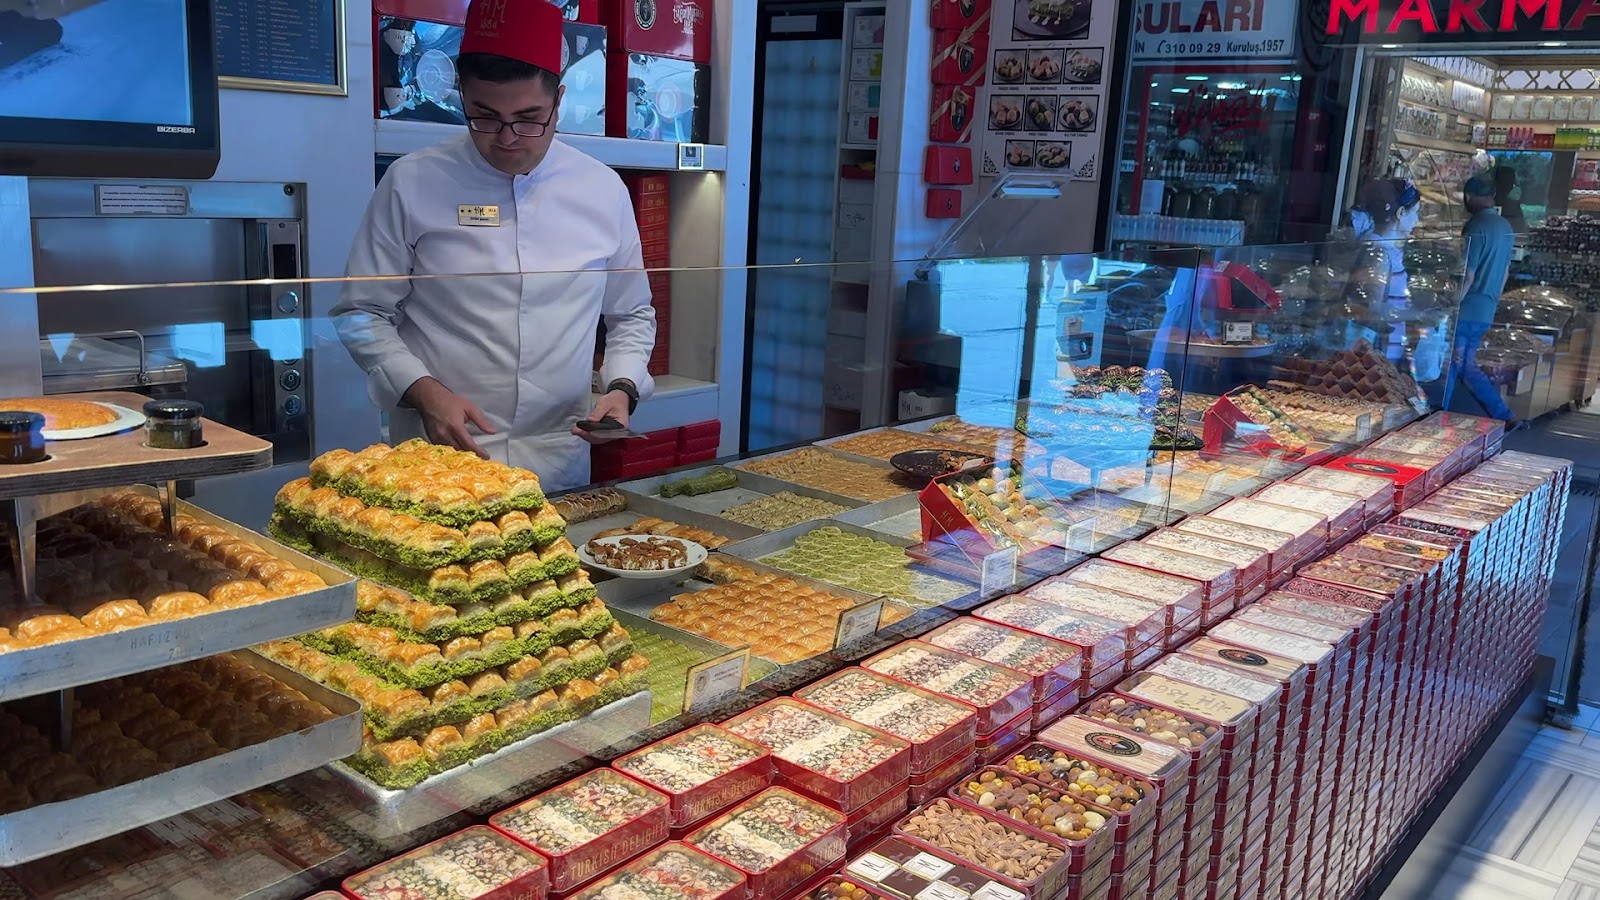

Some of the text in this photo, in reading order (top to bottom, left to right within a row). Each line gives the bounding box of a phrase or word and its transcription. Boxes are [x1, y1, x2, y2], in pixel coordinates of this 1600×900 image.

[1189, 43, 1203, 53] 09
[1207, 43, 1221, 53] 29
[157, 126, 195, 134] BIZERBA
[570, 820, 666, 880] TURKISH DELIGHT
